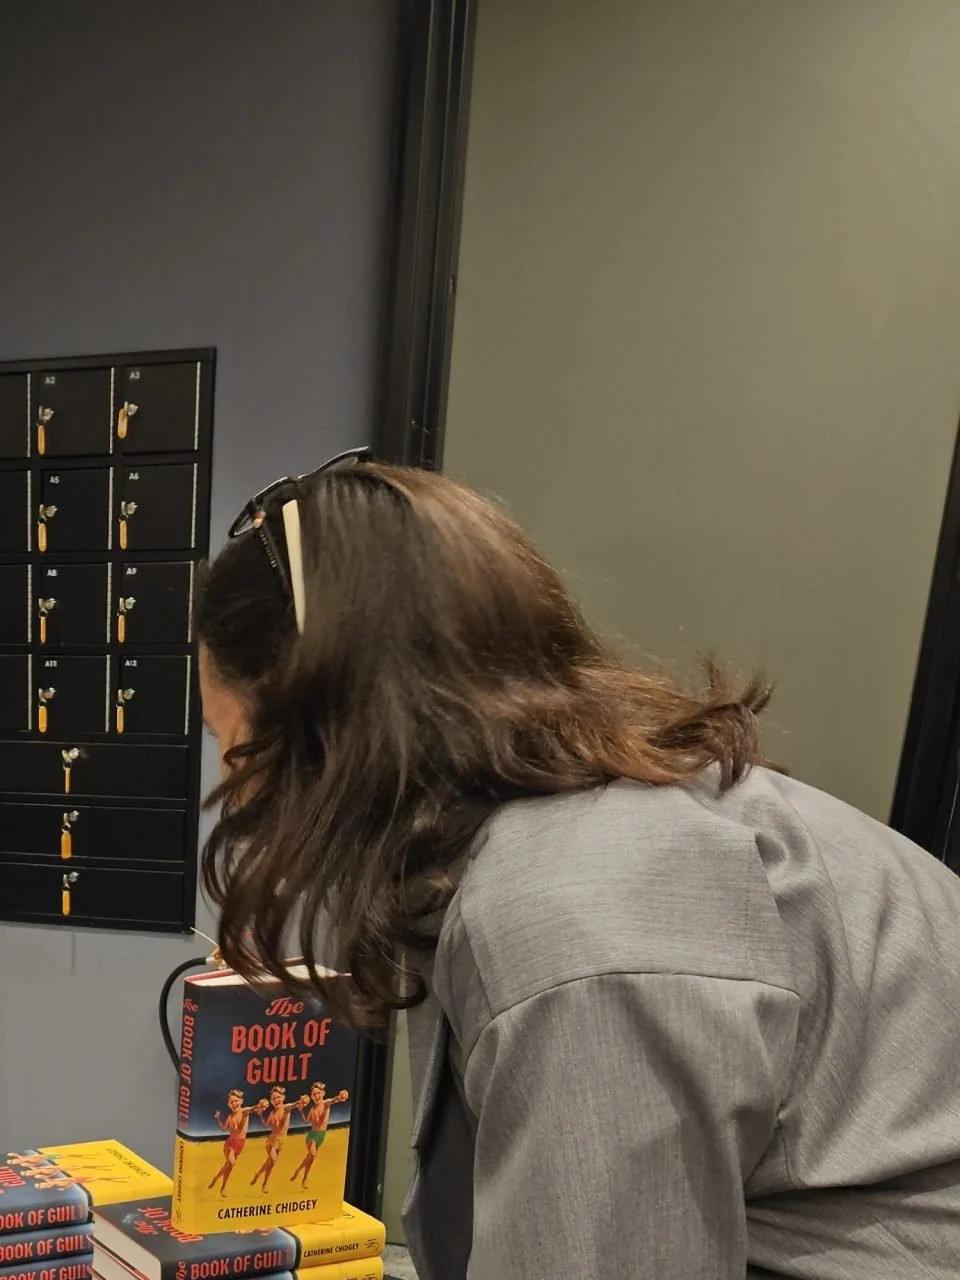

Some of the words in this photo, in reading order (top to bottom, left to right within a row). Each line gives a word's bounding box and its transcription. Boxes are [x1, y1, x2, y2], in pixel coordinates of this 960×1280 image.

[184, 998, 198, 1012] The
[265, 996, 304, 1017] The
[182, 1015, 194, 1061] BOOK
[231, 1021, 297, 1054] BOOK
[303, 1018, 332, 1048] OF
[180, 1063, 192, 1085] OF
[247, 1053, 312, 1085] GUILT
[28, 1209, 45, 1226] OF
[47, 1204, 85, 1223] GUILT
[136, 1207, 169, 1218] OF
[218, 1204, 272, 1220] CATHERINE
[275, 1198, 318, 1214] CHIDGEY
[37, 1239, 54, 1256] OF
[303, 1247, 333, 1258] CATHERINE
[335, 1243, 360, 1253] CHIDGEY
[191, 1258, 230, 1280] BOOK
[233, 1255, 251, 1273] OF
[254, 1248, 292, 1269] GUILT
